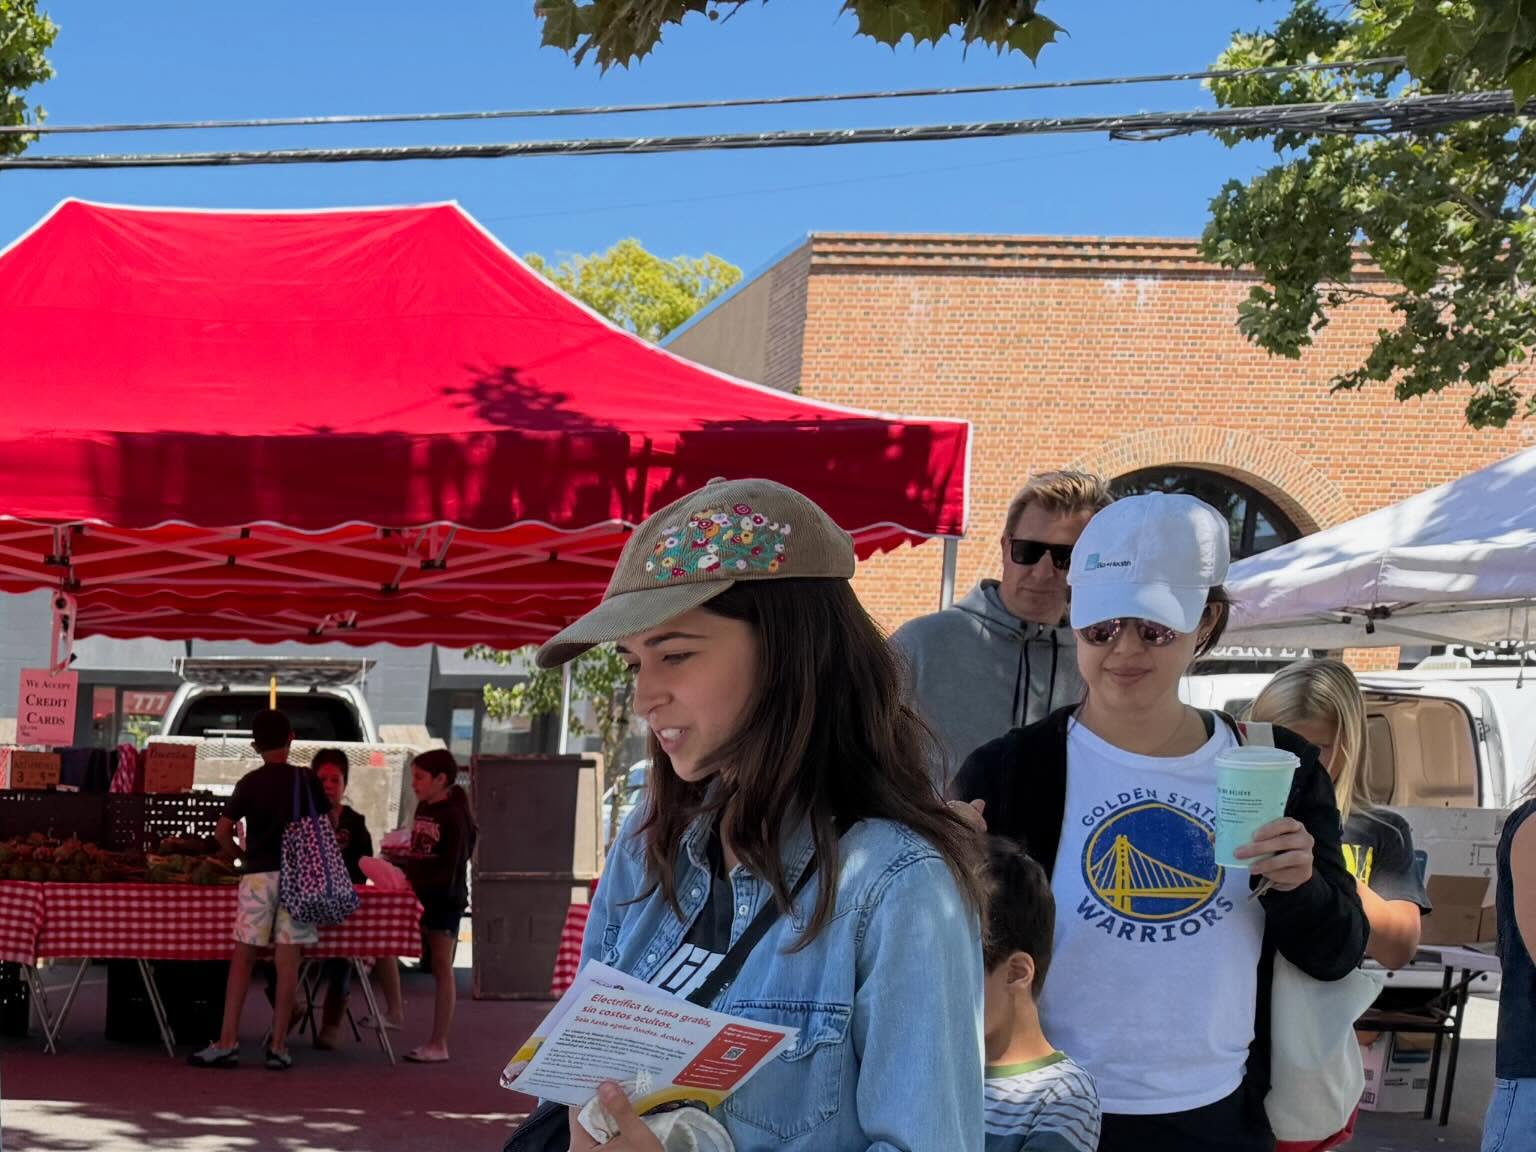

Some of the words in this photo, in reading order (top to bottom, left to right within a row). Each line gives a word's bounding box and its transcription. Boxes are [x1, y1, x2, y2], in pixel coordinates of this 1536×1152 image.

[26, 694, 68, 708] CREDIT
[26, 712, 65, 725] CARDS
[1082, 787, 1158, 828] GOLDEN
[1076, 895, 1234, 943] WARRIORS
[582, 1005, 597, 1014] sin
[598, 1009, 631, 1020] costos
[591, 994, 641, 1010] Electrifica
[644, 1004, 655, 1013] tu
[656, 1008, 680, 1019] casa
